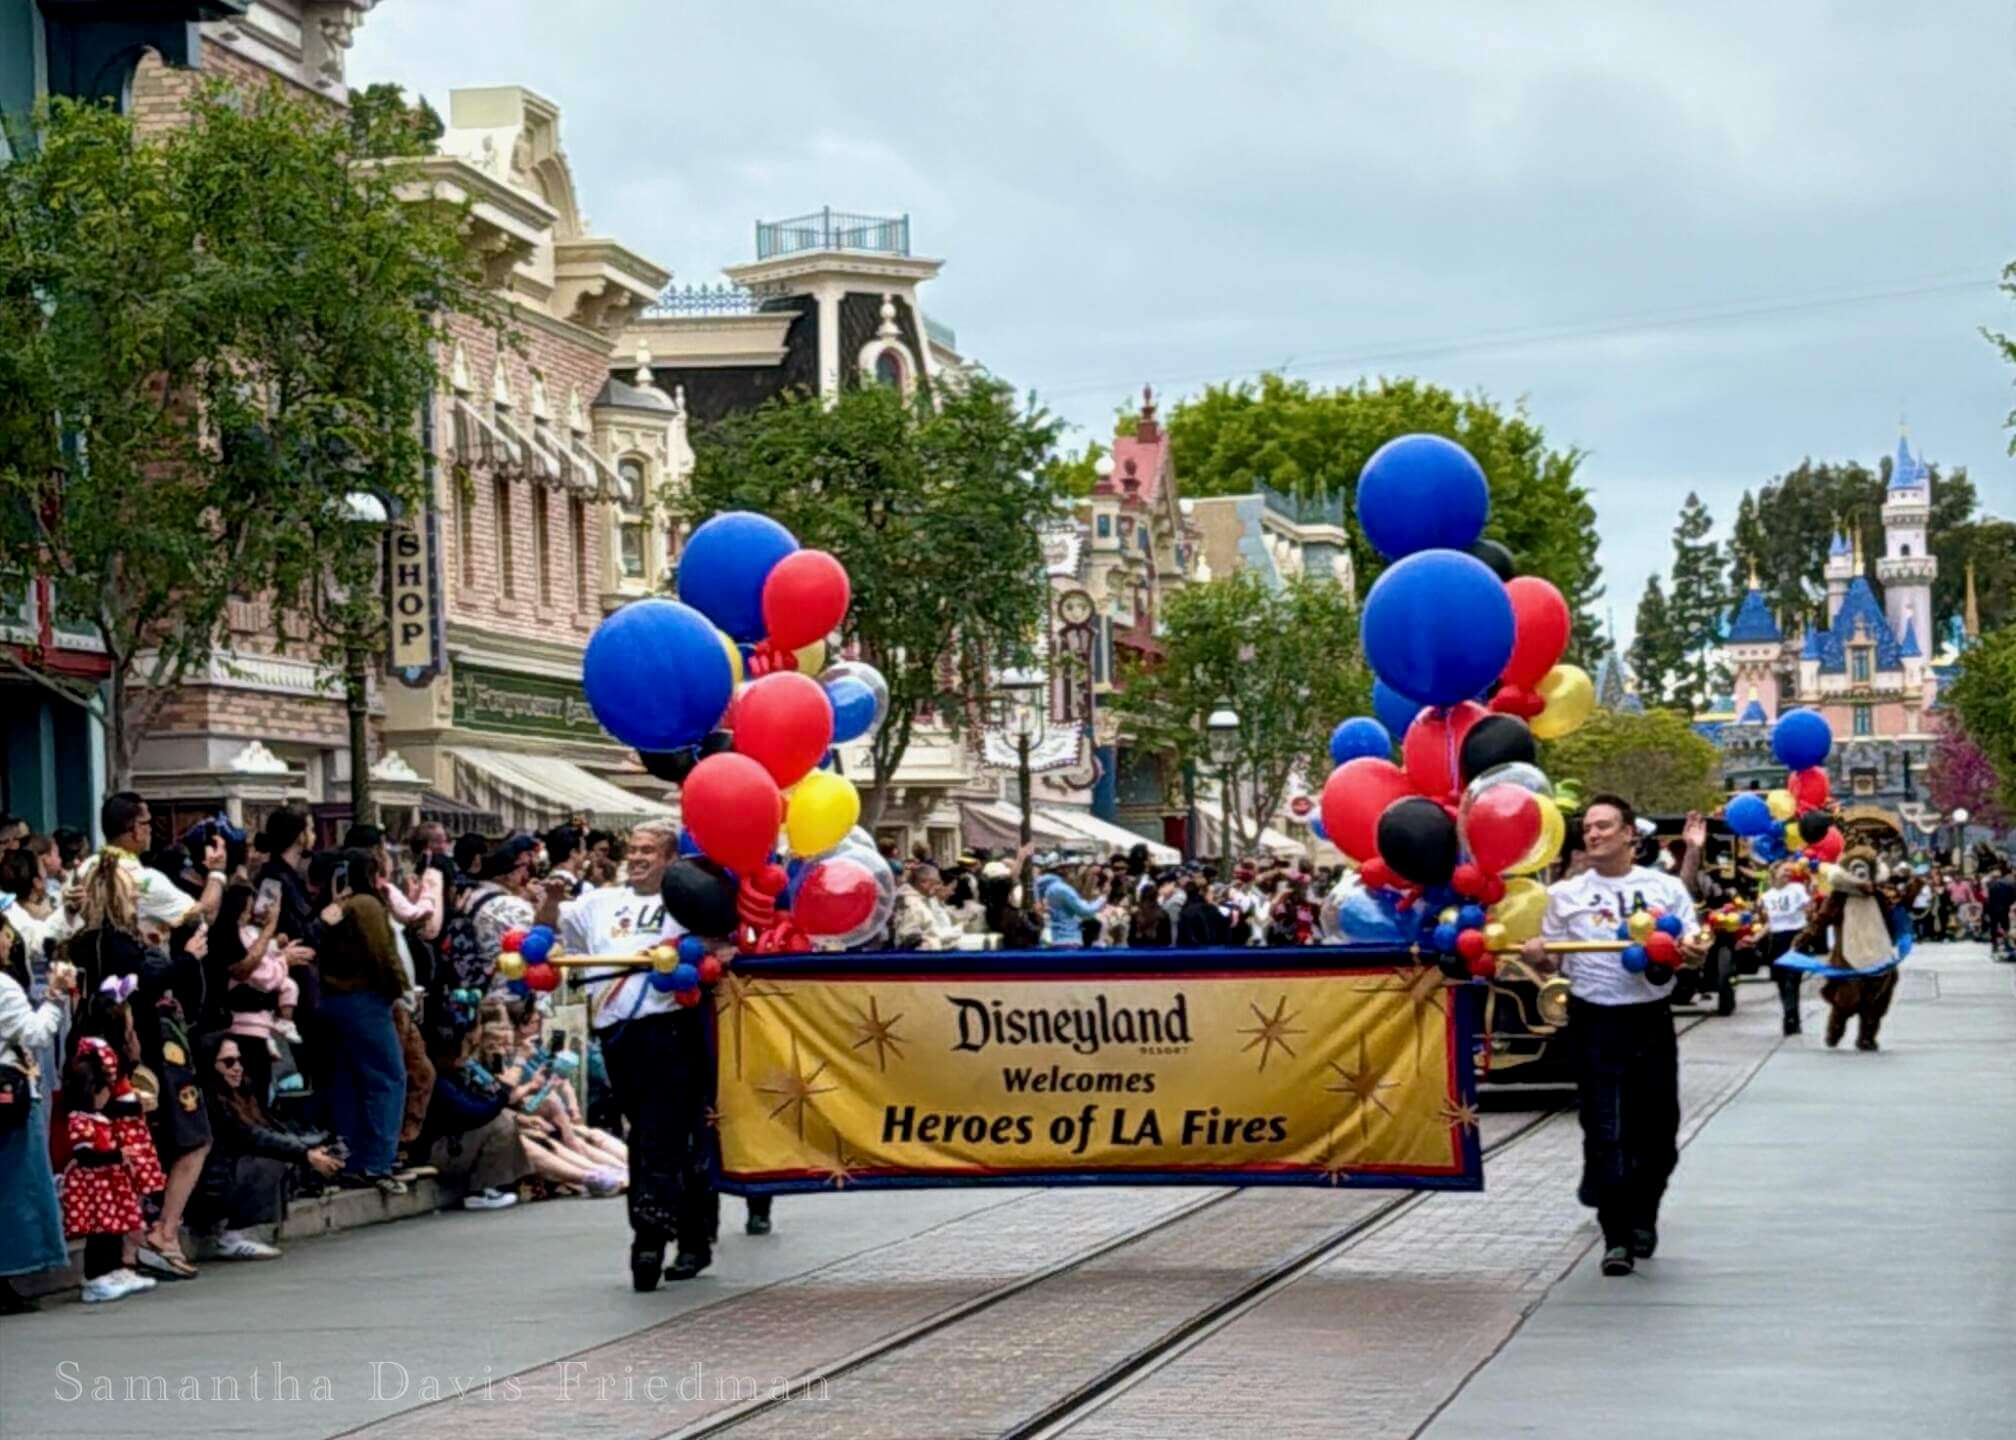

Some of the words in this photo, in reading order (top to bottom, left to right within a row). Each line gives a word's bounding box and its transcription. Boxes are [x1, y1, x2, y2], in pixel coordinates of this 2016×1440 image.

[397, 533, 424, 646] SHOP
[637, 904, 667, 929] LA
[945, 992, 1194, 1055] Disneyland
[1002, 1064, 1156, 1093] Welcomes
[881, 1105, 1033, 1144] Heroes
[1049, 1104, 1098, 1154] of
[1110, 1108, 1163, 1146] LA
[1180, 1106, 1288, 1146] Fires
